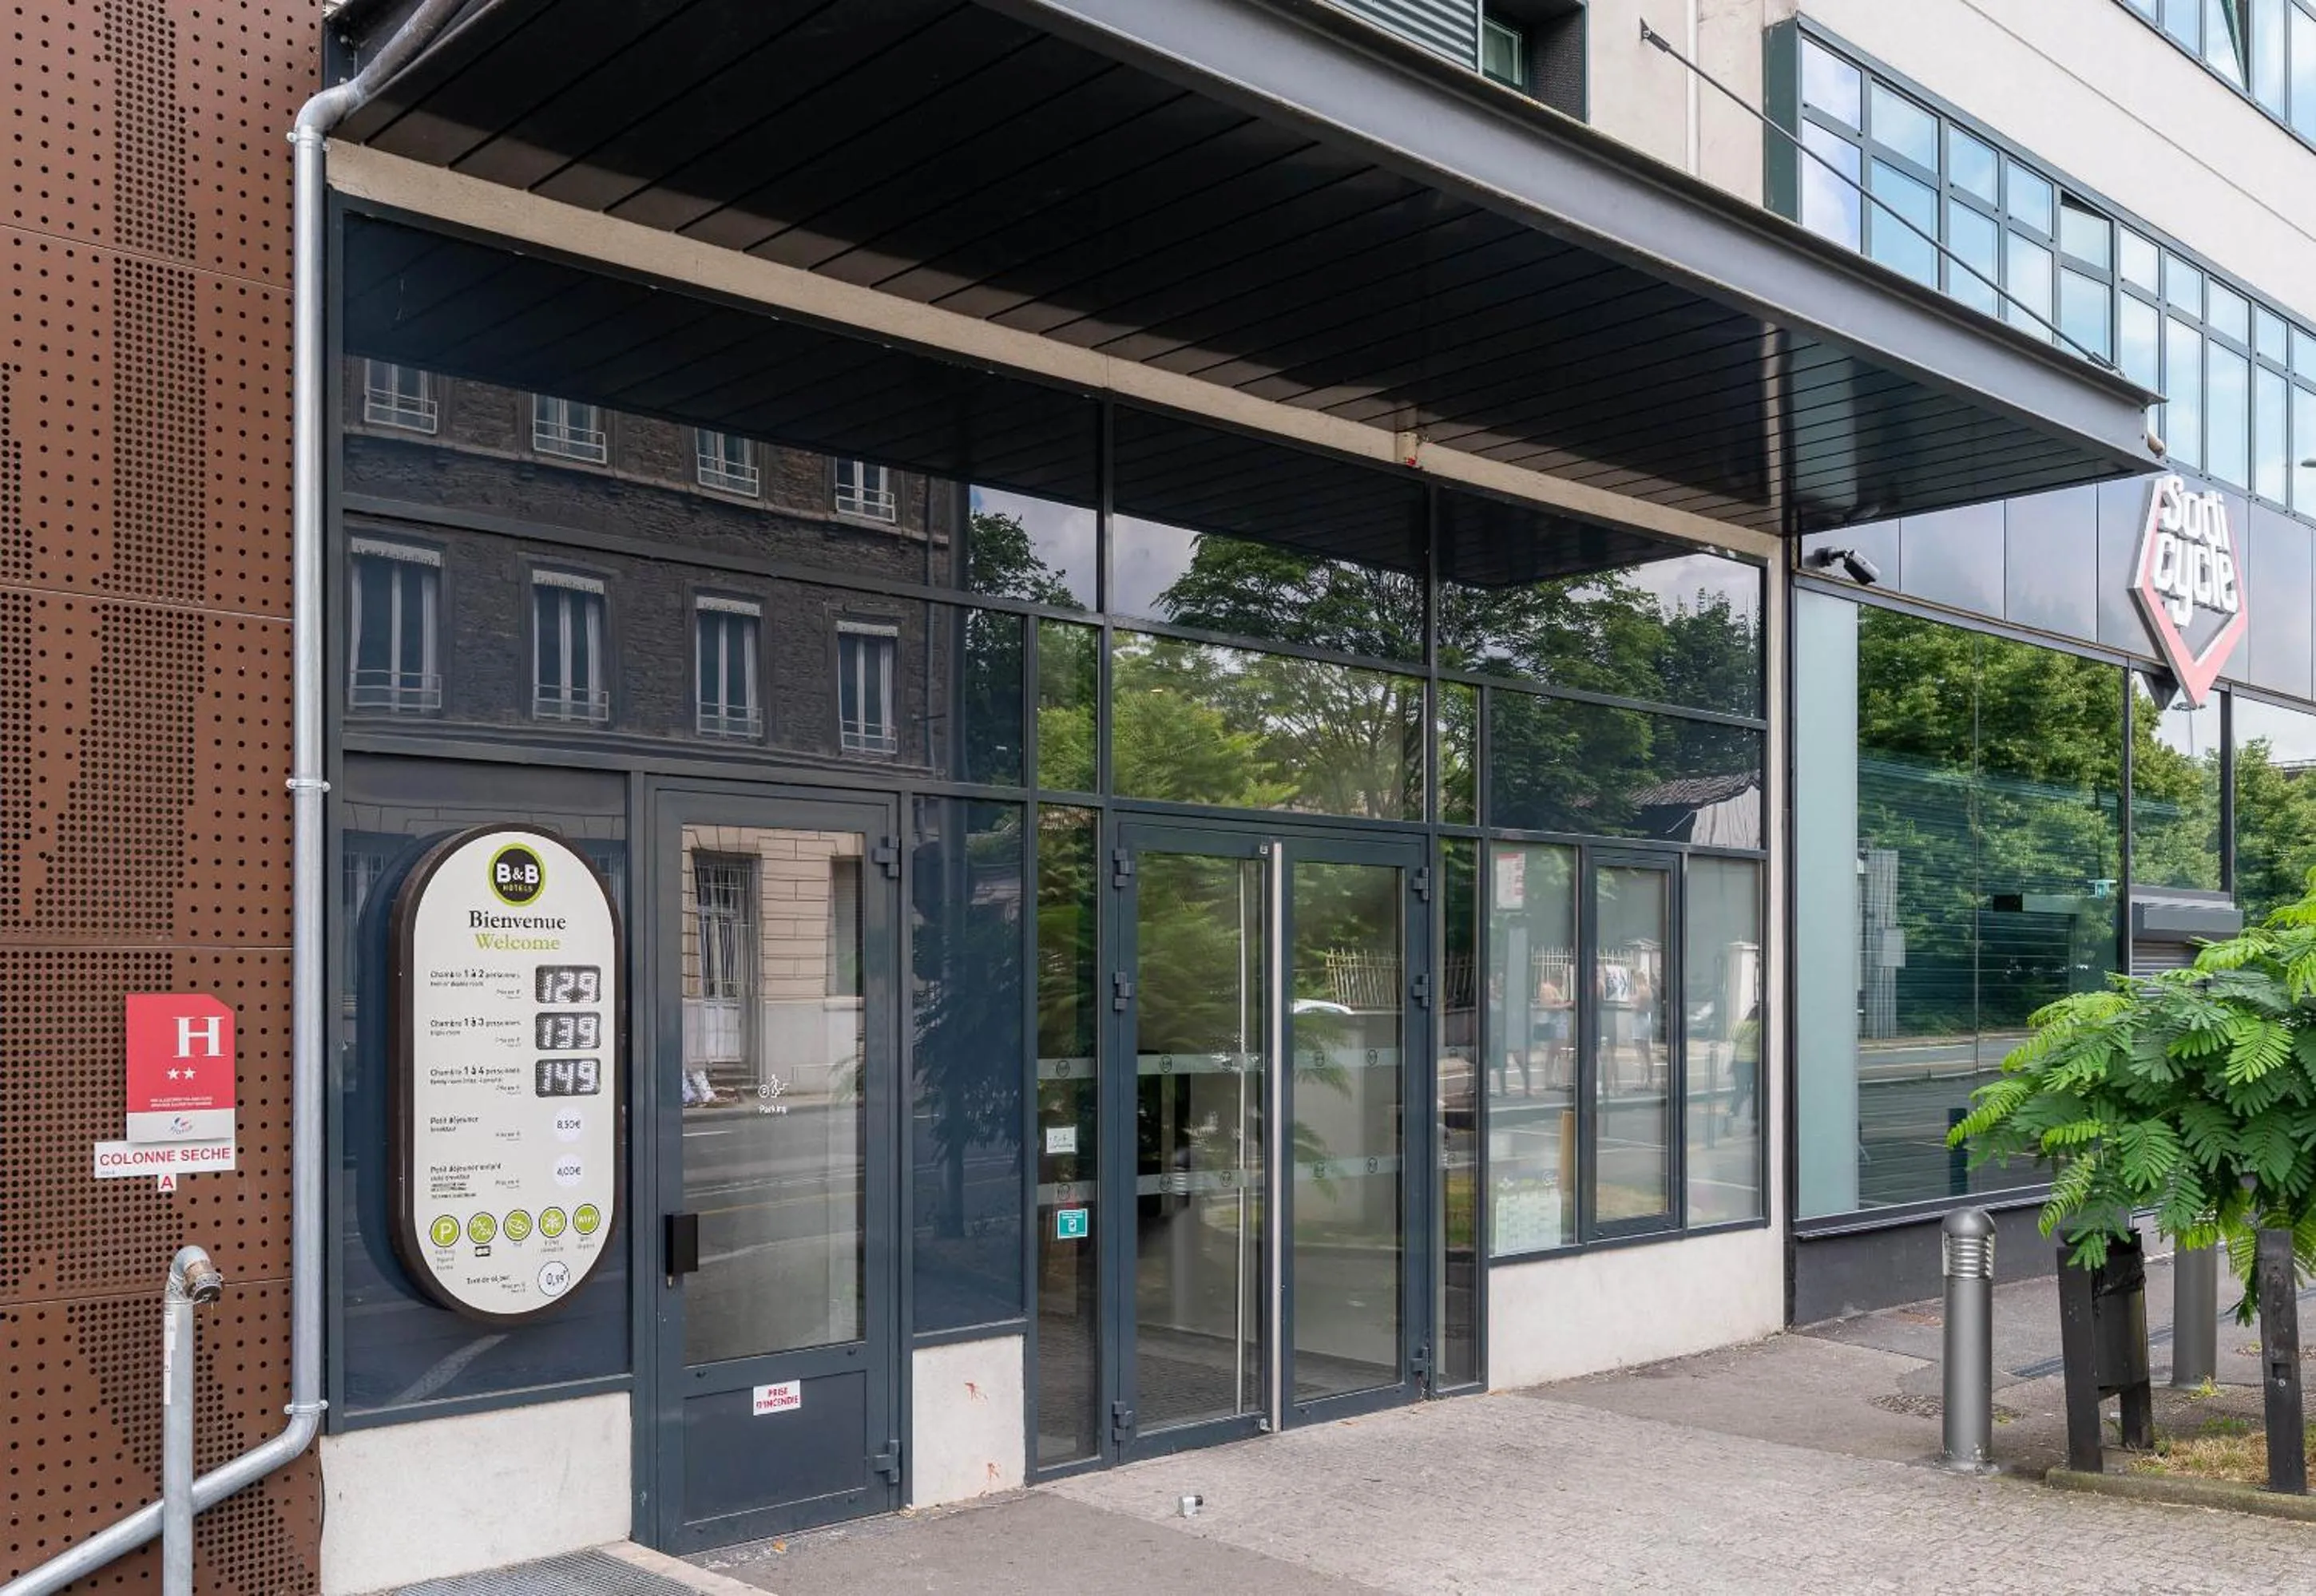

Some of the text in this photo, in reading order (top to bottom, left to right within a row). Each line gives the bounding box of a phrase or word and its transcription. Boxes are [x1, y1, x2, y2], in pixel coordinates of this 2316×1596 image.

[2160, 475, 2230, 552] Sodi
[2154, 533, 2238, 628] cycle
[497, 863, 539, 883] B&B
[502, 884, 533, 893] HOTELS
[469, 910, 566, 929] Bienvenue
[475, 933, 561, 949] Welcome
[545, 972, 597, 1003] 129
[173, 1016, 226, 1058] H
[545, 1017, 597, 1048] 139
[545, 1060, 597, 1093] 149
[100, 1147, 231, 1166] COLONNE SECHE
[160, 1175, 173, 1189] A
